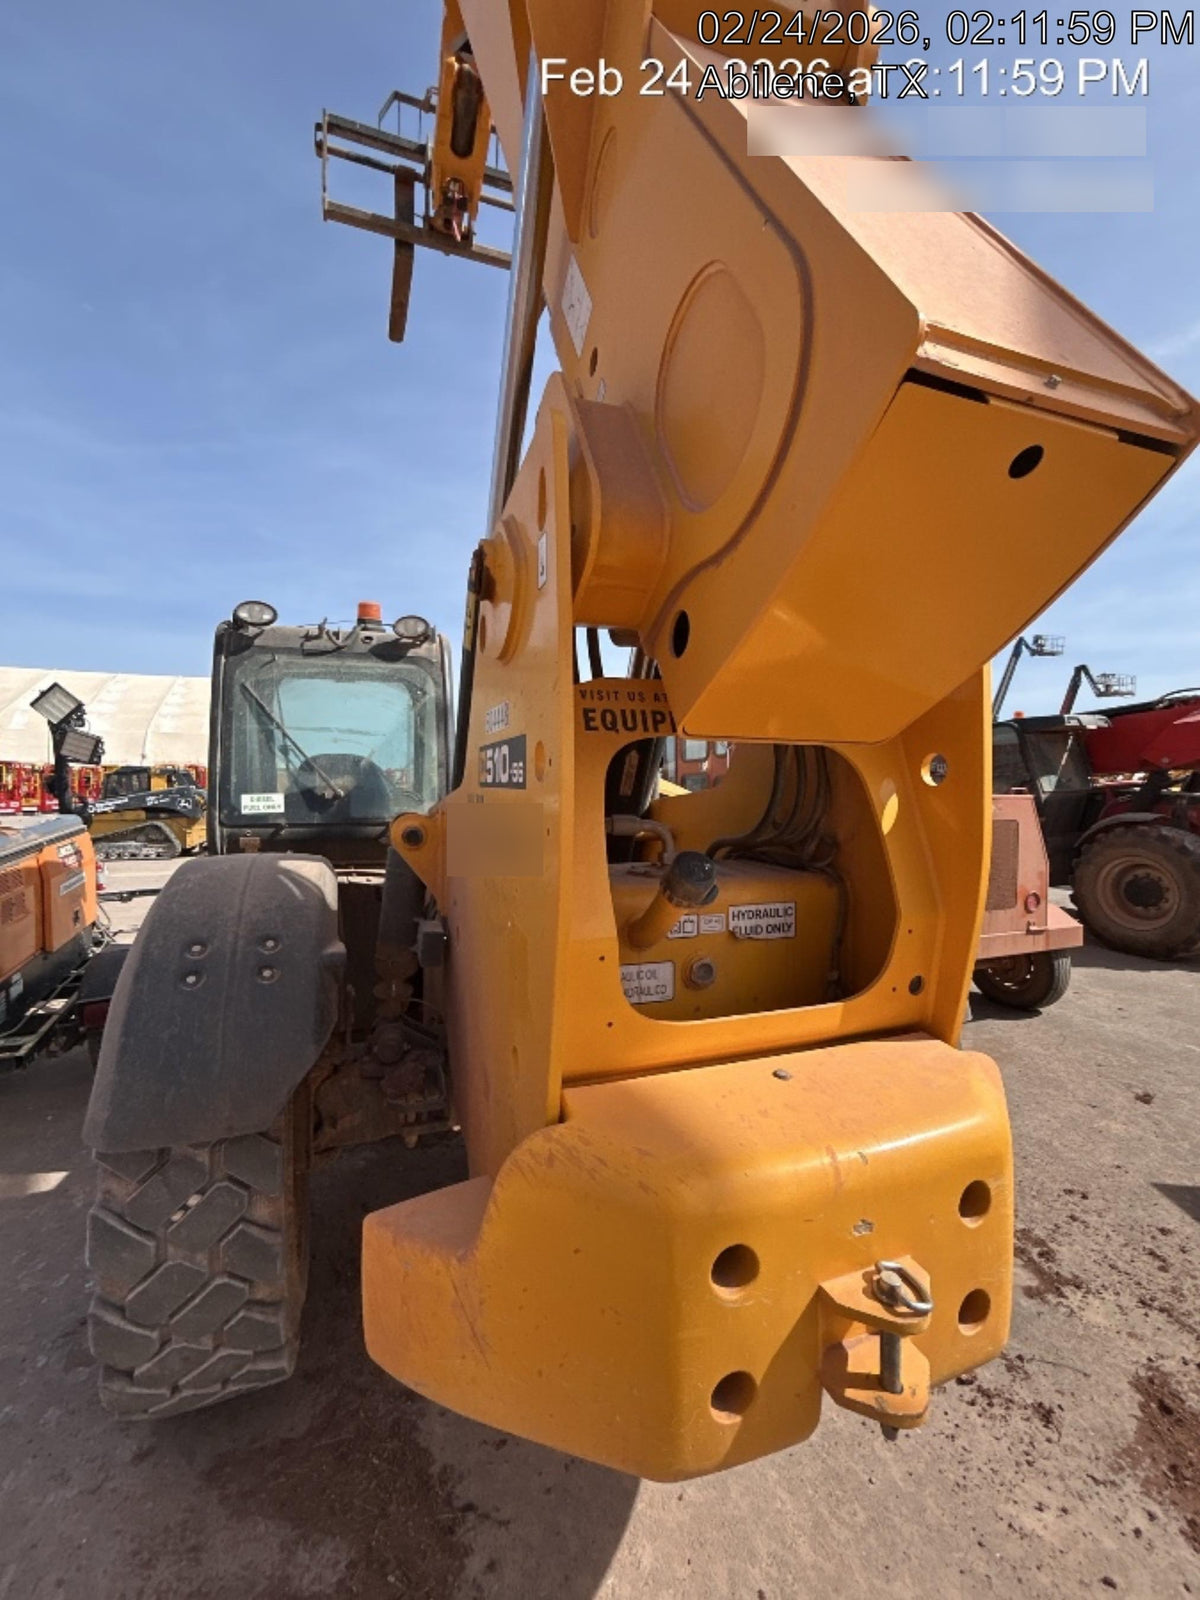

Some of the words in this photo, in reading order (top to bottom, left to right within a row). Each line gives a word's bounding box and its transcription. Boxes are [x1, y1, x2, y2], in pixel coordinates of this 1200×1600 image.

[579, 688, 619, 702] VISIT
[627, 690, 646, 703] US
[583, 707, 678, 734] EQUIP
[731, 905, 794, 922] HYDRAULIC
[766, 922, 794, 934] ONLY
